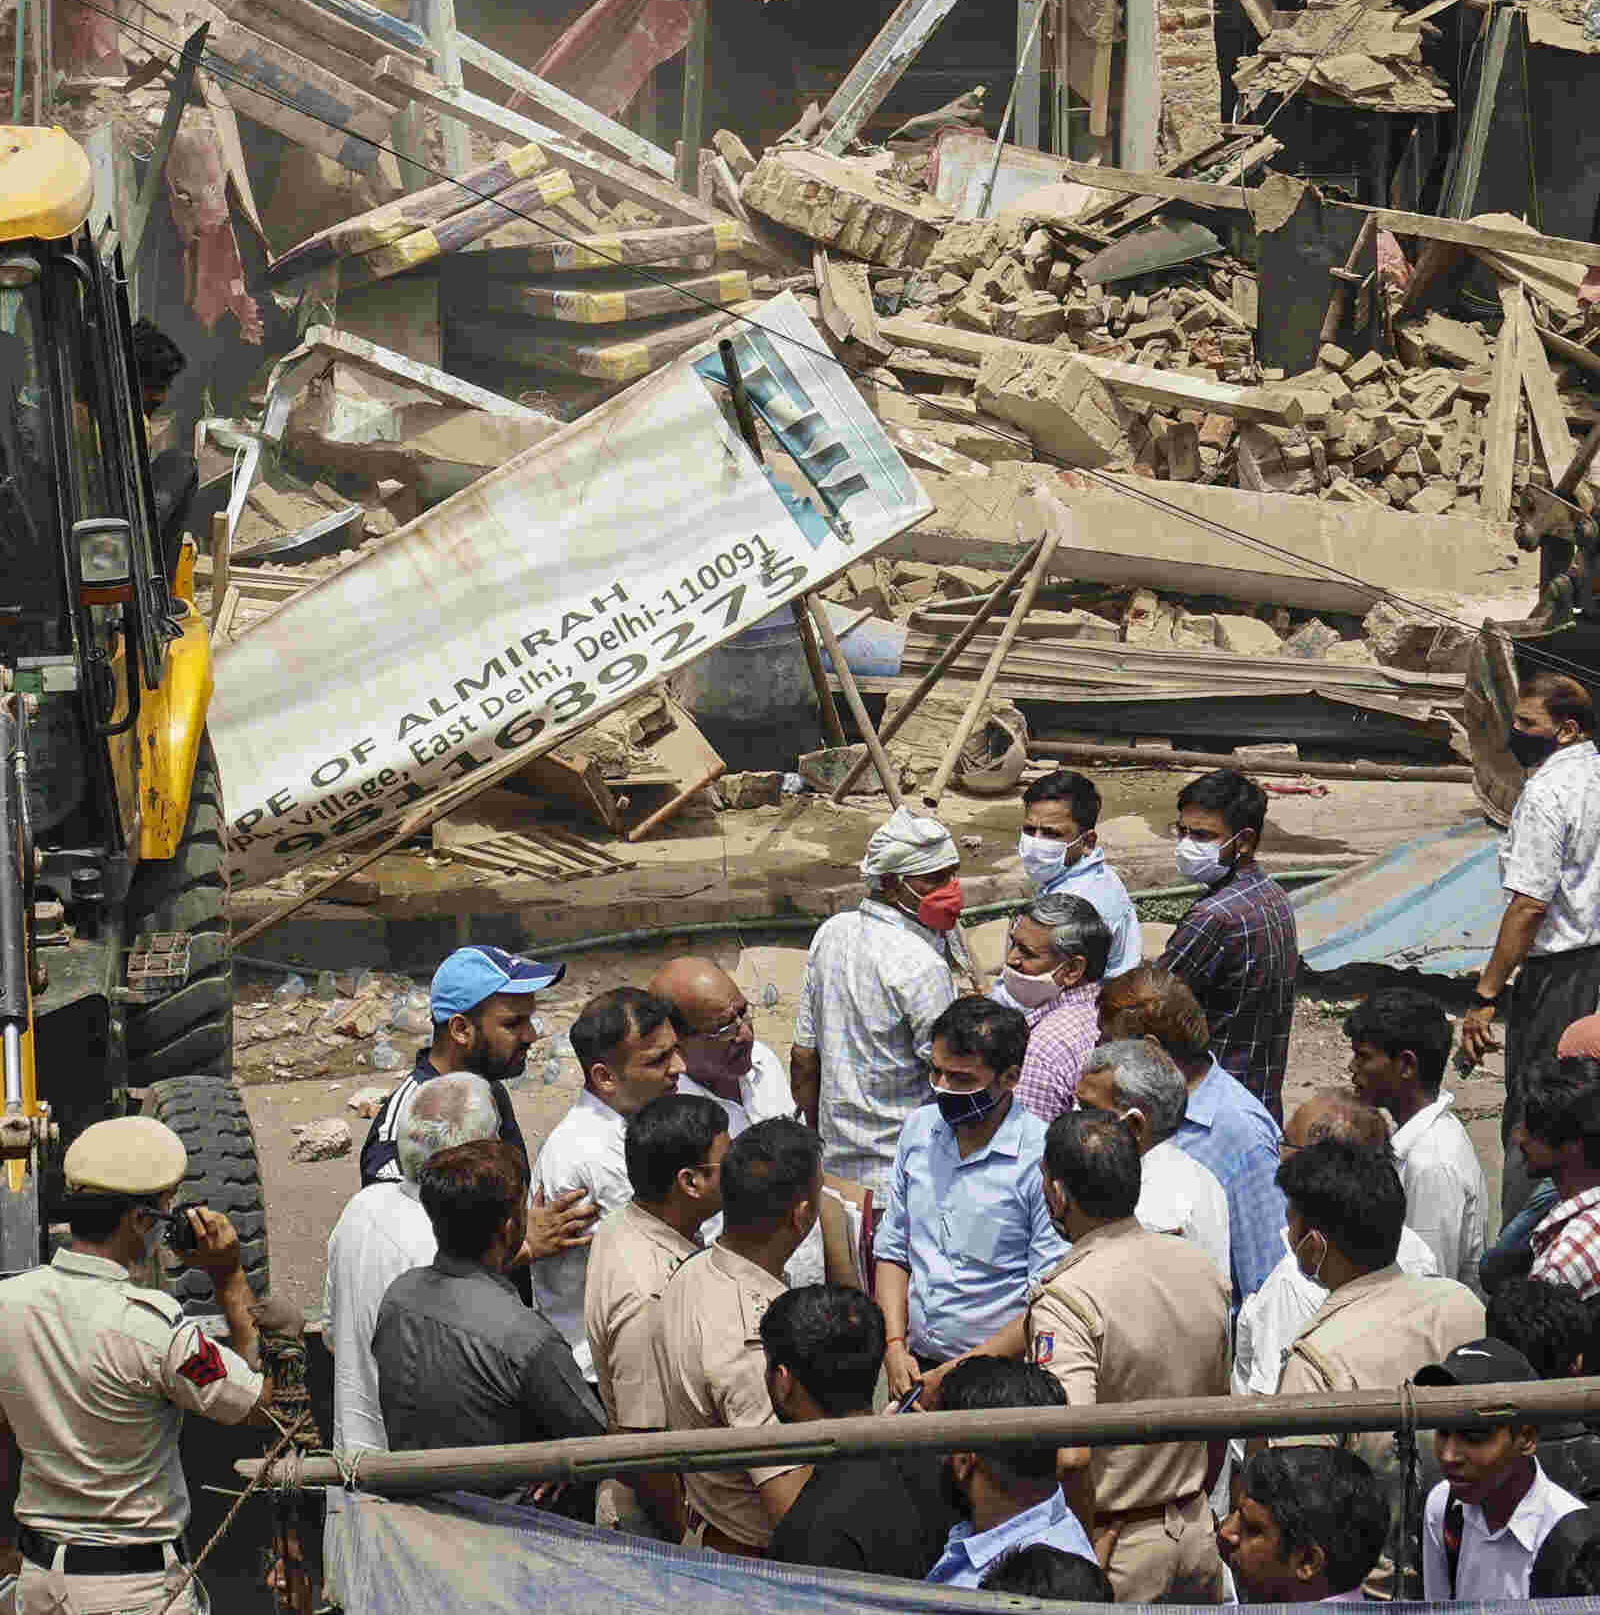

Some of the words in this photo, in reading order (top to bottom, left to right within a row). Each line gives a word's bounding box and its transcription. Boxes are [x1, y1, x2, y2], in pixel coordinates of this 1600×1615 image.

[234, 787, 299, 834] PE
[310, 736, 377, 787] OF
[398, 581, 630, 742] ALMIRAH
[273, 555, 809, 854] 9811639275
[289, 766, 409, 827] Village,
[408, 713, 479, 767] East
[479, 656, 574, 721] Delhi,
[573, 533, 777, 663] Delhi-110091
